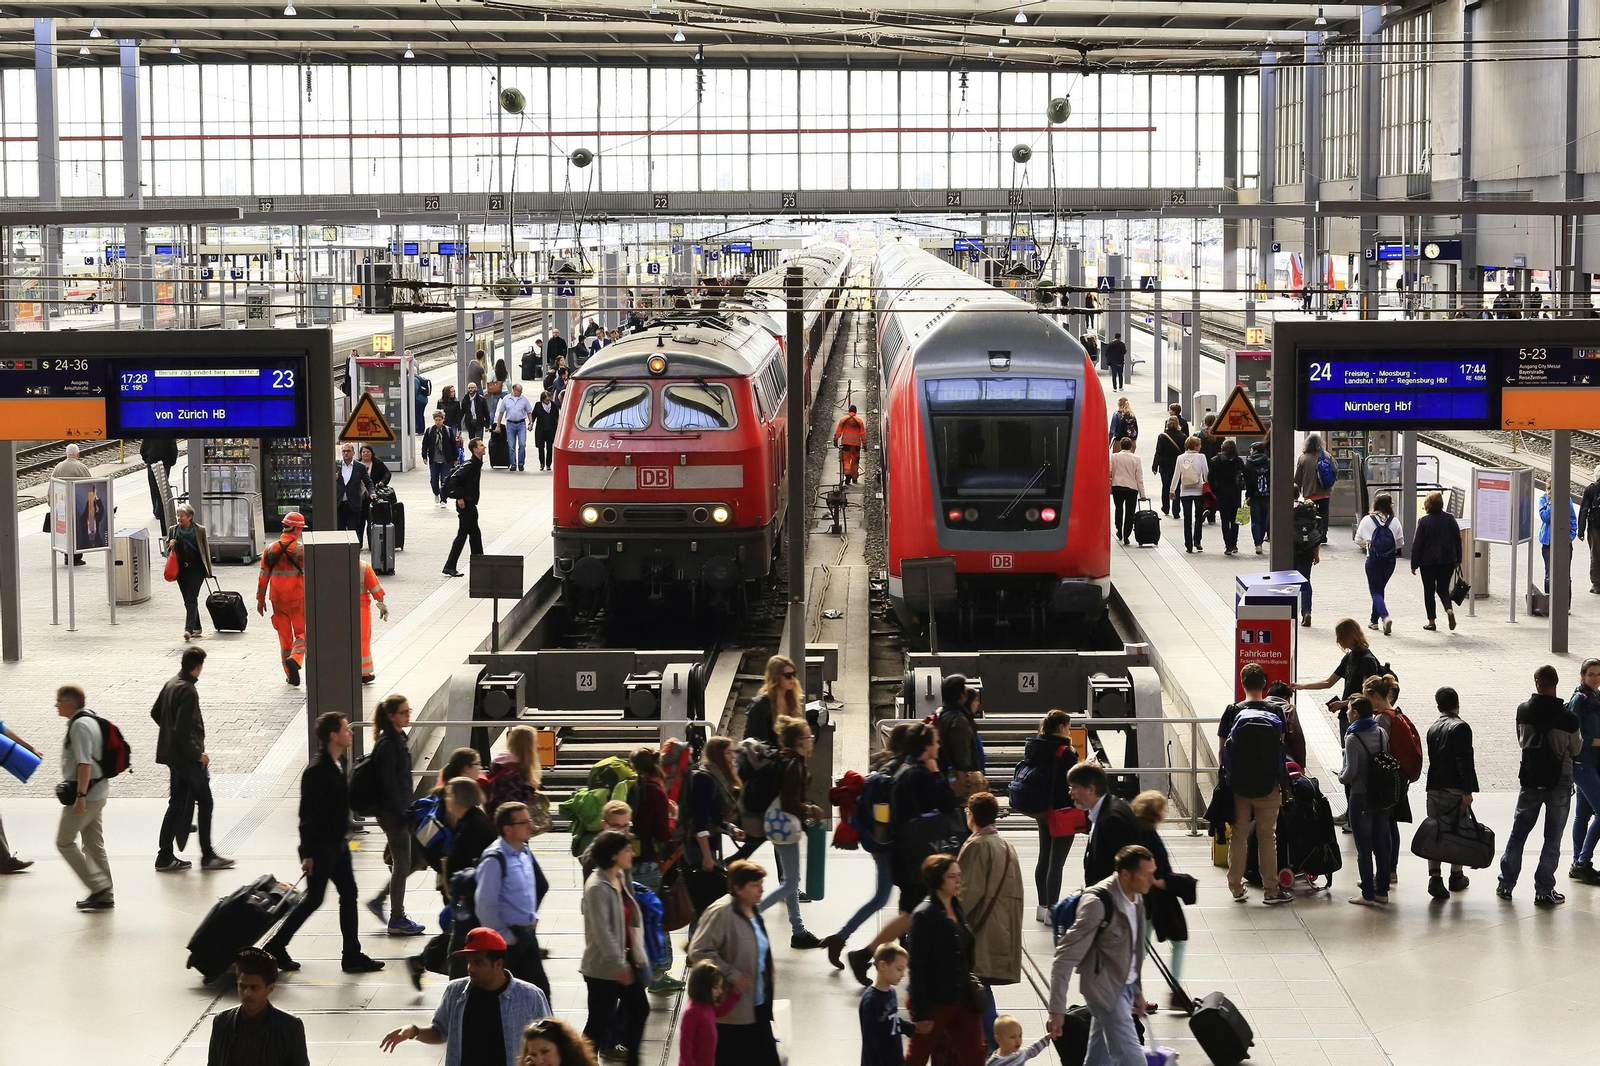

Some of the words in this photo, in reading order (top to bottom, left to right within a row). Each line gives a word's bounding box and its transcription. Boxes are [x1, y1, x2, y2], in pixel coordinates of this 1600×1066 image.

[655, 199, 667, 208] 22
[783, 198, 795, 207] 23
[948, 196, 960, 205] 24
[1172, 195, 1185, 204] 26
[261, 203, 271, 212] 19
[425, 201, 439, 210] 20
[492, 200, 501, 209] 21
[1272, 243, 1278, 251] C
[1365, 249, 1373, 258] B
[202, 269, 209, 277] B
[651, 264, 659, 273] B
[562, 280, 573, 294] A
[1100, 277, 1110, 290] A
[1145, 277, 1156, 290] A
[1519, 348, 1547, 360] 5-23
[1578, 350, 1586, 358] U
[42, 361, 50, 370] S
[55, 359, 89, 371] 24-36
[1460, 364, 1486, 374] 17:44
[1309, 362, 1332, 381] 24
[1344, 370, 1370, 378] Freising
[1379, 370, 1410, 378] Moosburg
[121, 374, 148, 384] 17:28
[272, 369, 295, 389] 23
[1397, 378, 1435, 386] Regensburg
[1344, 401, 1390, 413] Nürnberg
[1395, 401, 1412, 411] Hbf
[155, 411, 173, 420] von
[177, 409, 208, 419] Zürich
[212, 409, 226, 419] HB
[568, 439, 585, 449] 218
[589, 439, 623, 449] 454-7
[643, 470, 667, 486] DB
[993, 556, 1011, 568] DB
[1239, 649, 1282, 658] Fahrkarten
[580, 674, 592, 687] 23
[1022, 675, 1035, 688] 24
